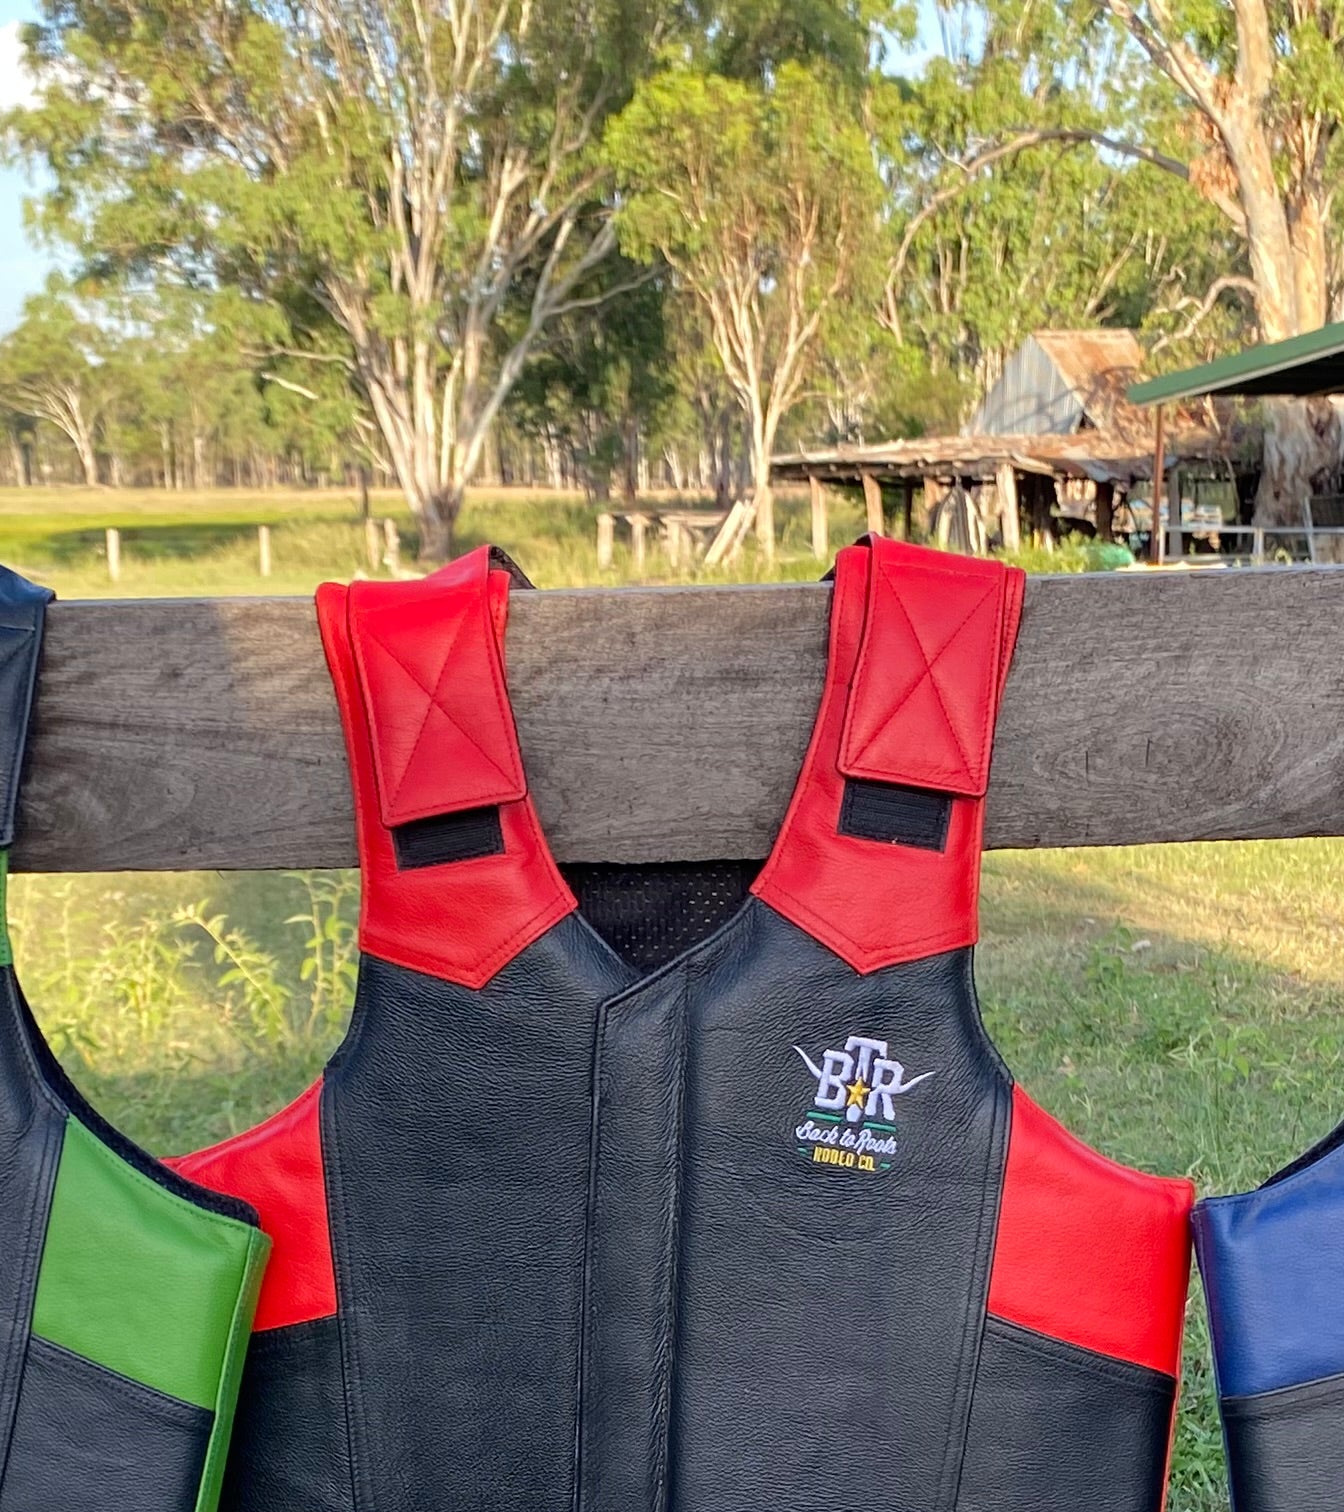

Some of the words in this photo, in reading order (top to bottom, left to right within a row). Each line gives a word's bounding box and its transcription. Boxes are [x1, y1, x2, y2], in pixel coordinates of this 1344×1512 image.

[814, 1036, 905, 1123] BTR
[796, 1120, 839, 1145] Back
[839, 1128, 856, 1147] to
[854, 1128, 897, 1155] Roots
[813, 1146, 855, 1168] RODEO
